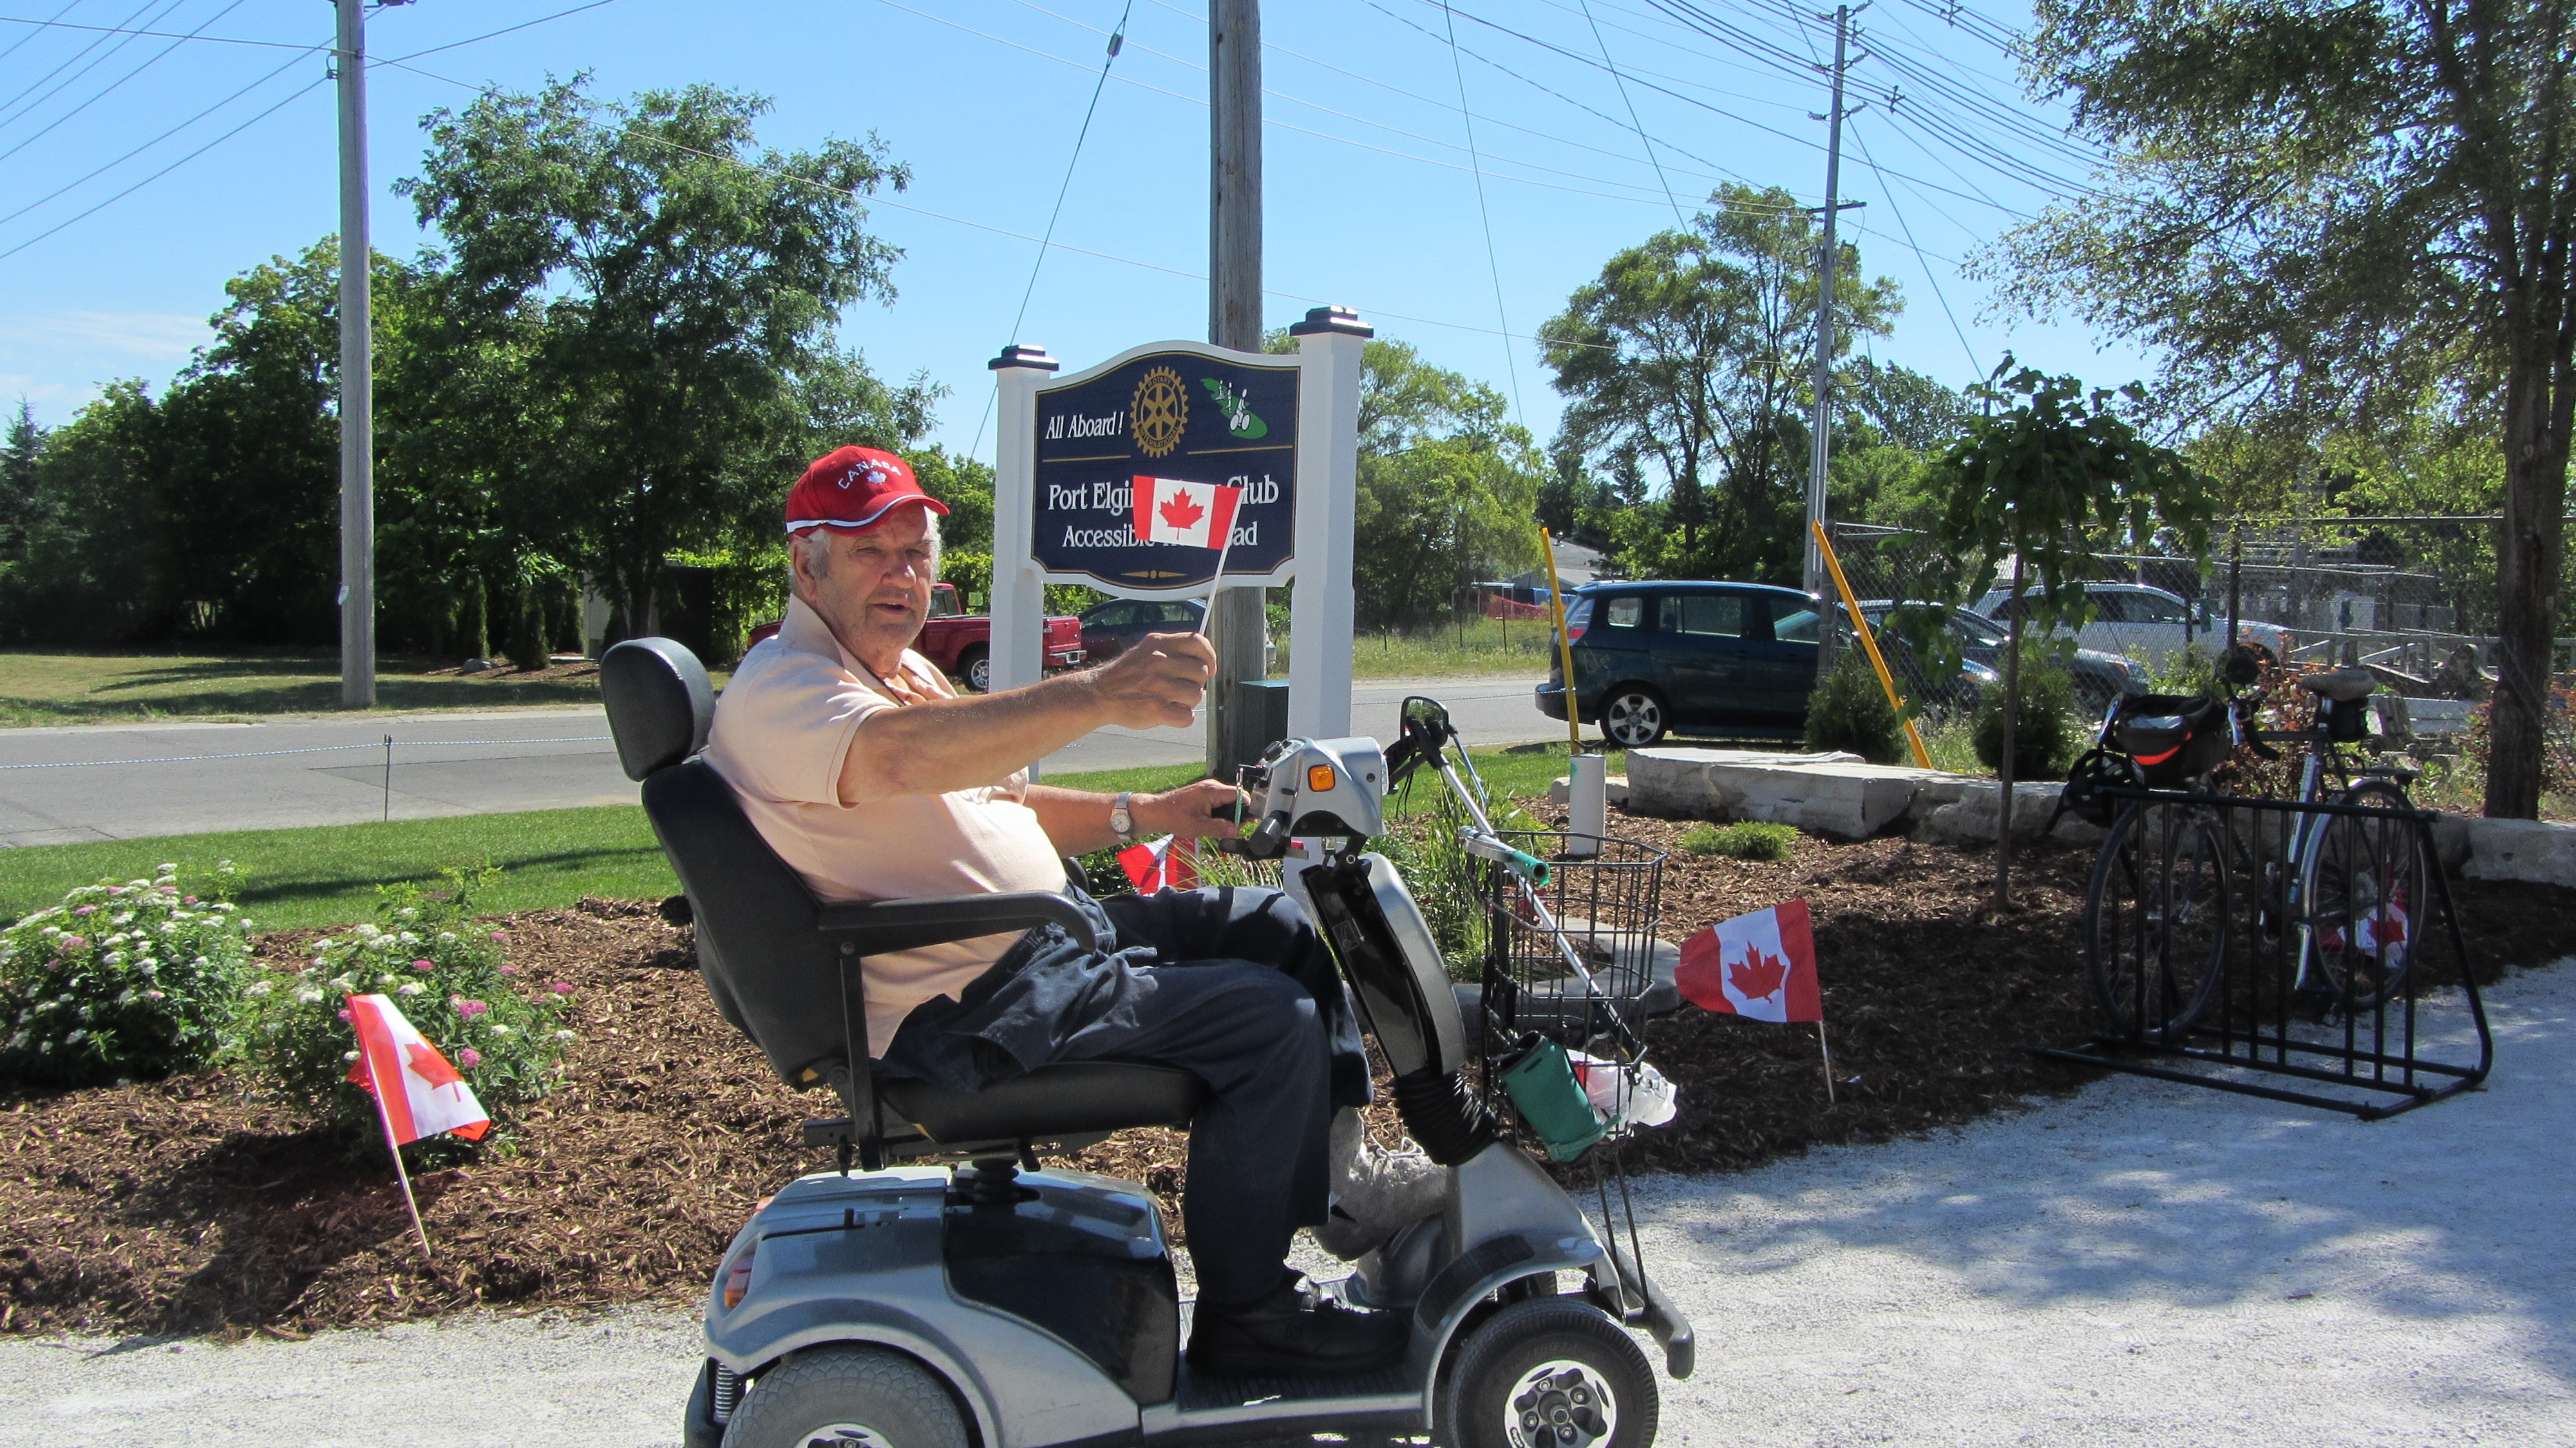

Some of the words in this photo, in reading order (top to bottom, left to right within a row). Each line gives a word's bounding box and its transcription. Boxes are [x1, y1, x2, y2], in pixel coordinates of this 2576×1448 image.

[1148, 375, 1171, 388] ROTARY
[1045, 415, 1065, 439] All
[1137, 424, 1180, 449] INTERNATIONAL
[837, 458, 902, 490] CANADA
[1048, 484, 1088, 510] Port
[1062, 524, 1155, 548] Accessib
